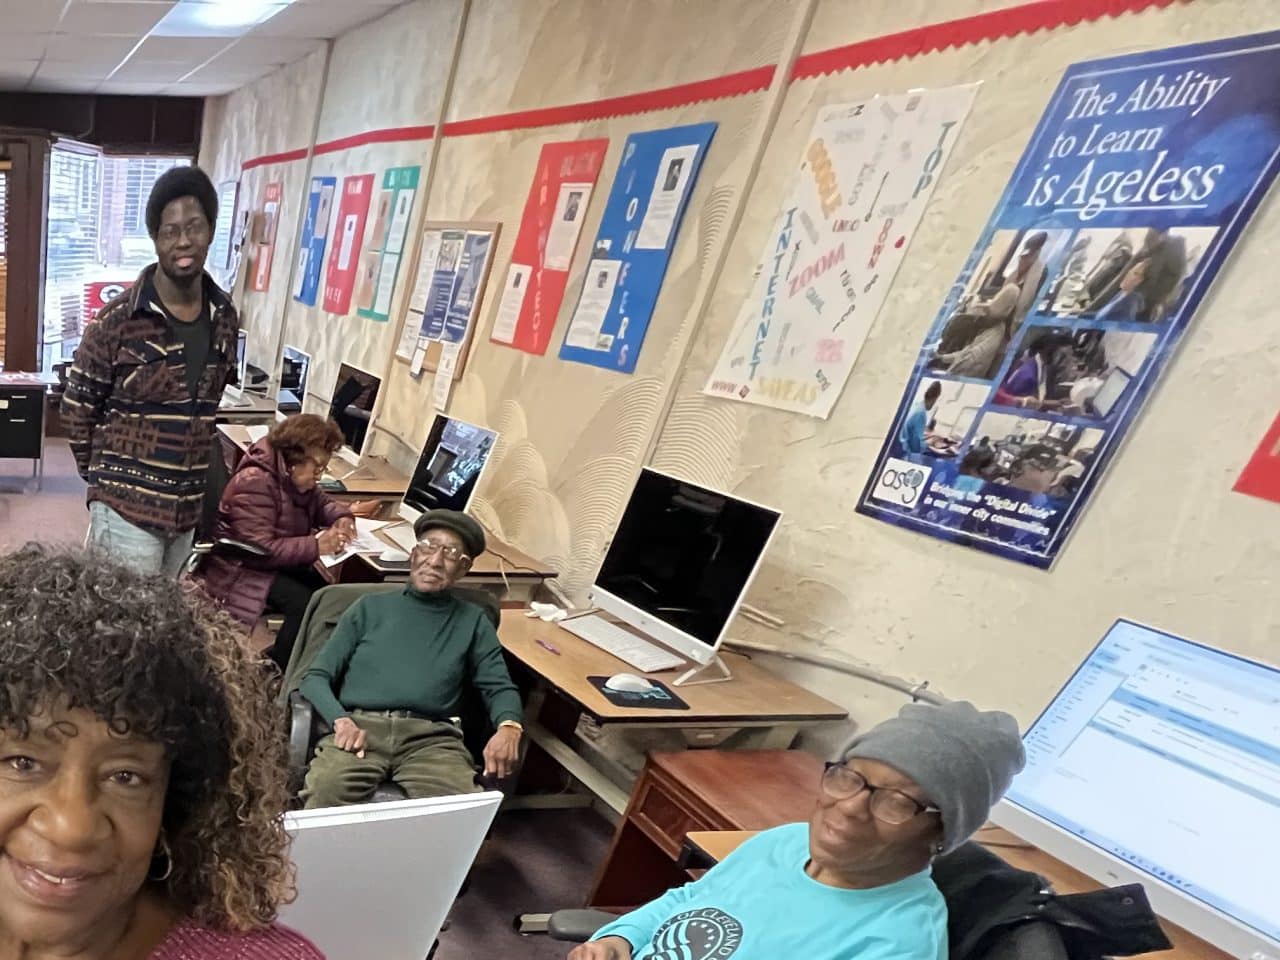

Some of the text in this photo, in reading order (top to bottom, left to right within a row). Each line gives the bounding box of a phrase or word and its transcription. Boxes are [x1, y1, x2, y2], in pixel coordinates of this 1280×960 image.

[1067, 70, 1231, 119] The Ability
[1048, 124, 1163, 159] to Learn
[1023, 151, 1225, 220] is Ageless
[749, 207, 797, 381] INTERNET
[787, 242, 844, 299] ZOOM
